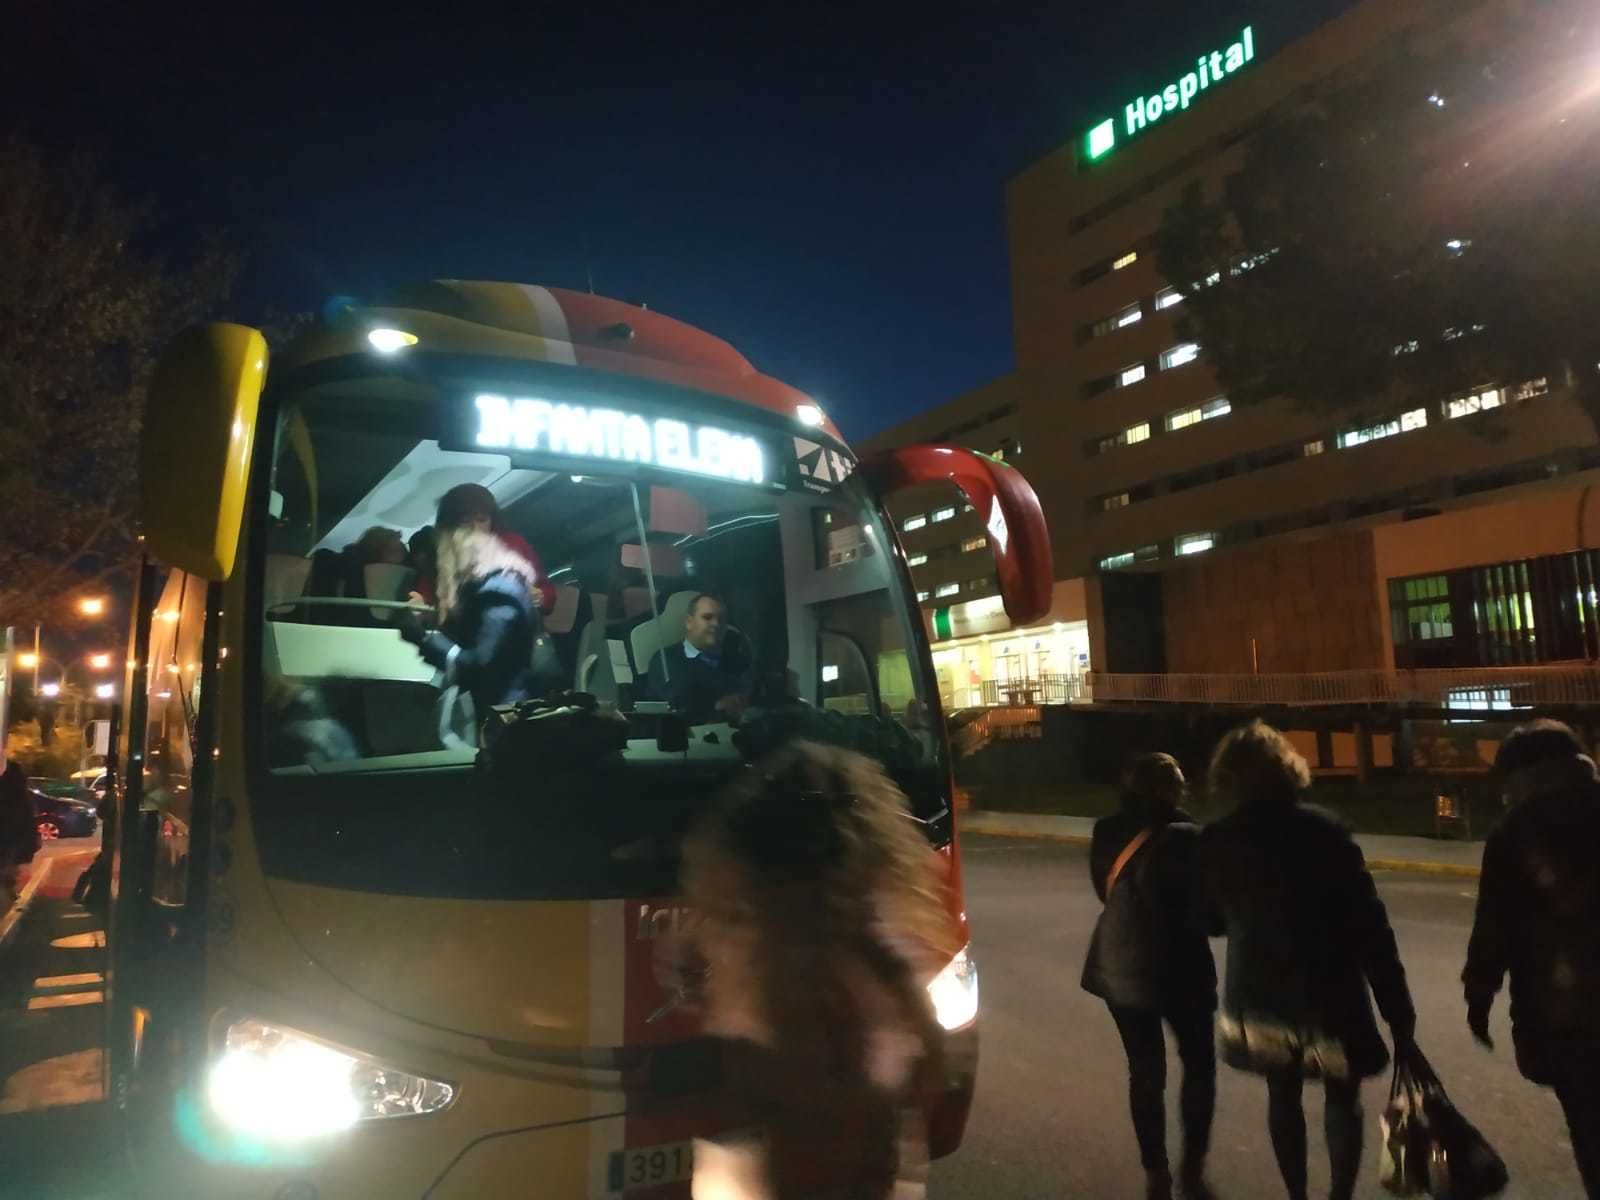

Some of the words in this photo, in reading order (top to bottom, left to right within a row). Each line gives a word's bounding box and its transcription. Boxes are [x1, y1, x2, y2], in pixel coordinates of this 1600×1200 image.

[1125, 25, 1254, 135] Hospital
[475, 395, 652, 463] INFANTA
[654, 418, 764, 483] ELENA
[629, 1148, 692, 1183] 391
